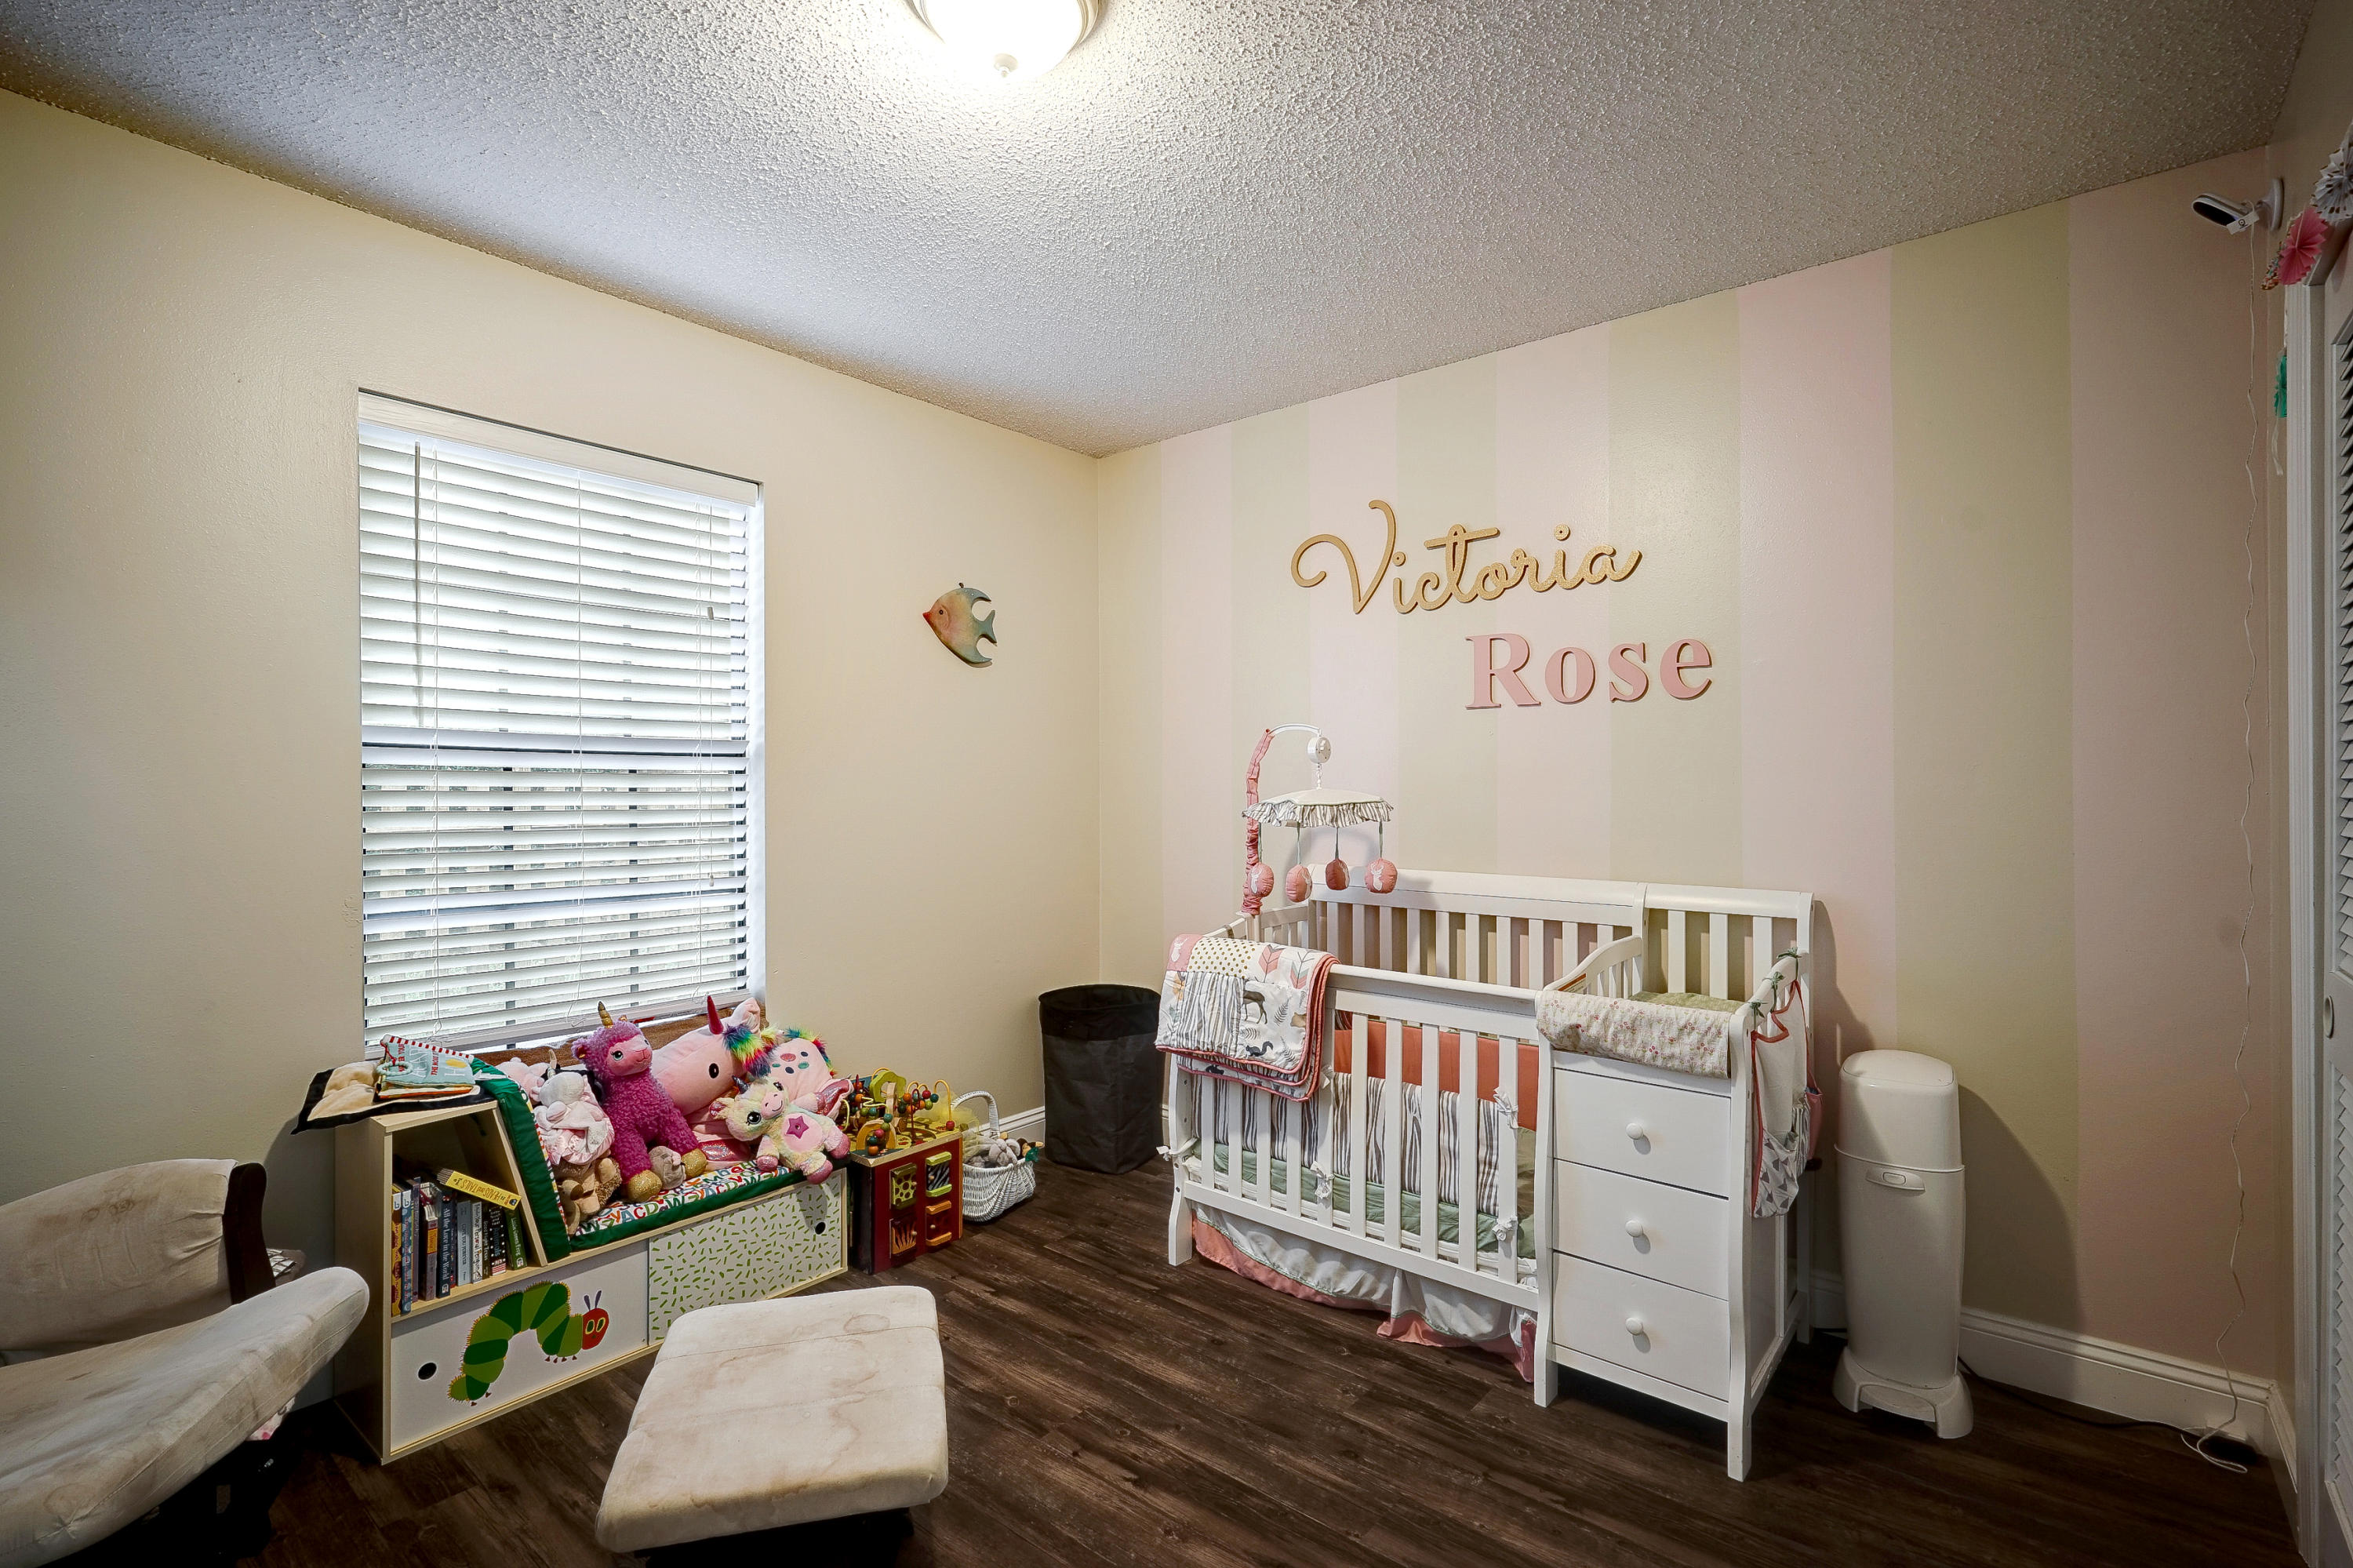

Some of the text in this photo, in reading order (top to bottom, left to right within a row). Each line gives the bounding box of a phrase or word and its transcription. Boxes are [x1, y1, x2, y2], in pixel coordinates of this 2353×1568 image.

[1290, 499, 1642, 614] Victoria
[1464, 631, 1712, 710] Rose
[460, 1179, 478, 1193] TAILS
[442, 1228, 451, 1243] Love
